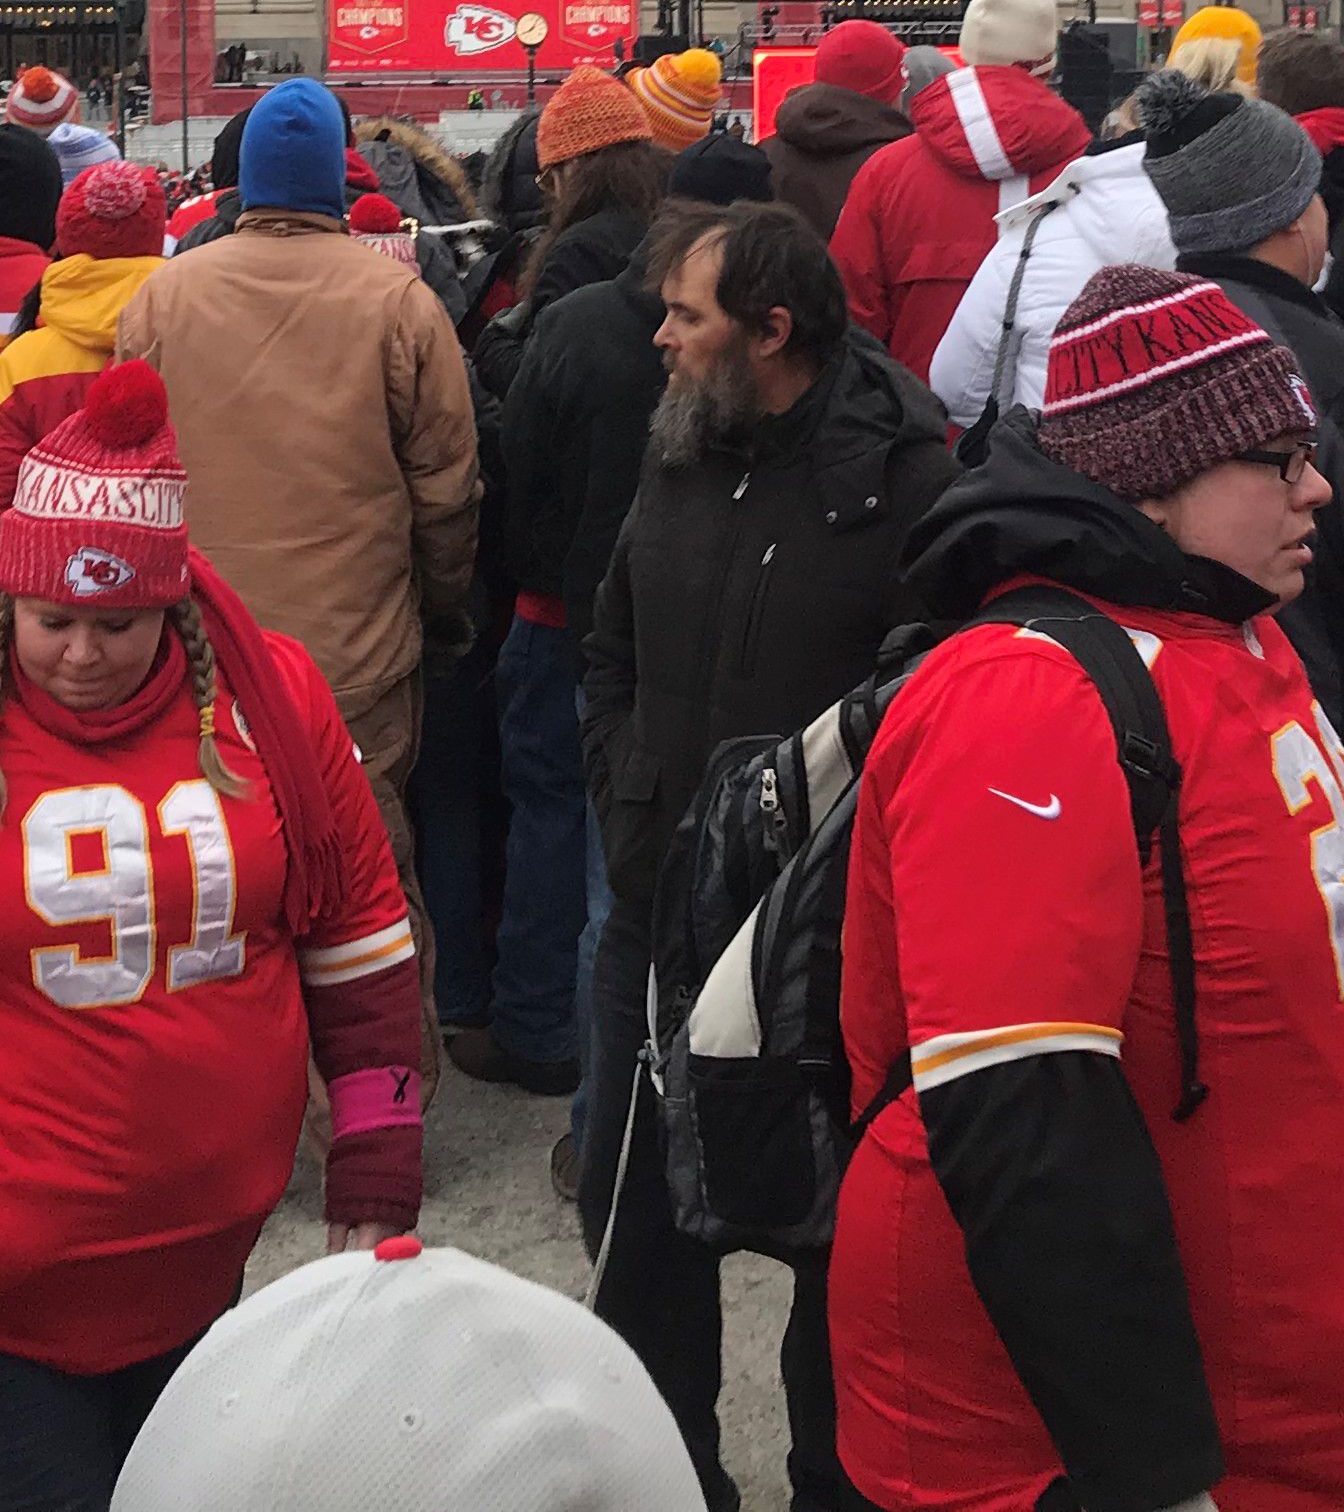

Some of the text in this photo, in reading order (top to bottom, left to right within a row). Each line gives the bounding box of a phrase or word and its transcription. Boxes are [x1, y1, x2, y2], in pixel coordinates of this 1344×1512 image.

[337, 7, 403, 28] CHAMPIONS
[565, 5, 630, 25] CHAMPIONS
[1054, 324, 1132, 393] CITY
[20, 777, 249, 1010] 91
